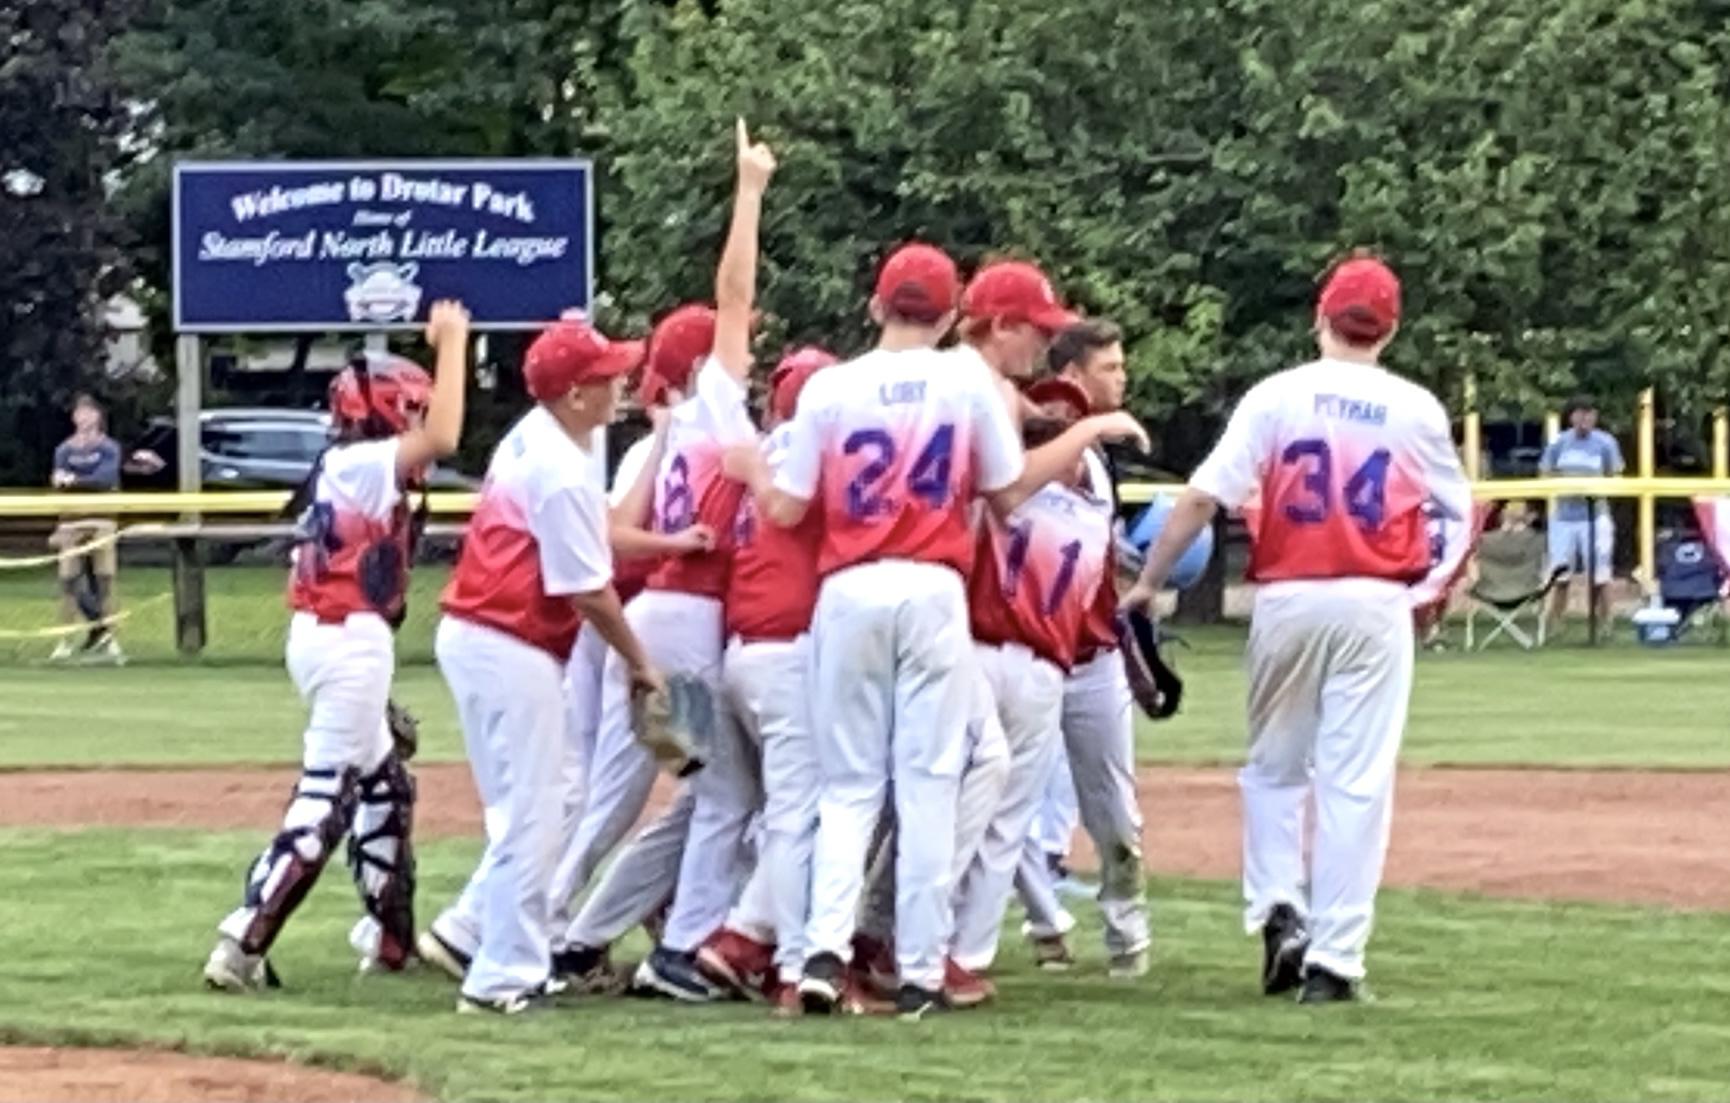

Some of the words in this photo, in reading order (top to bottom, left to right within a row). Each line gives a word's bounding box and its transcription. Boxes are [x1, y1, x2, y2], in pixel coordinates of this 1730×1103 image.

[231, 183, 344, 222] Welcome
[350, 176, 376, 201] to
[472, 182, 535, 223] Park
[198, 229, 316, 267] Stamford
[319, 231, 394, 260] North
[399, 229, 470, 259] Little
[472, 229, 569, 266] League
[843, 423, 954, 522] 24
[1282, 438, 1391, 535] 34
